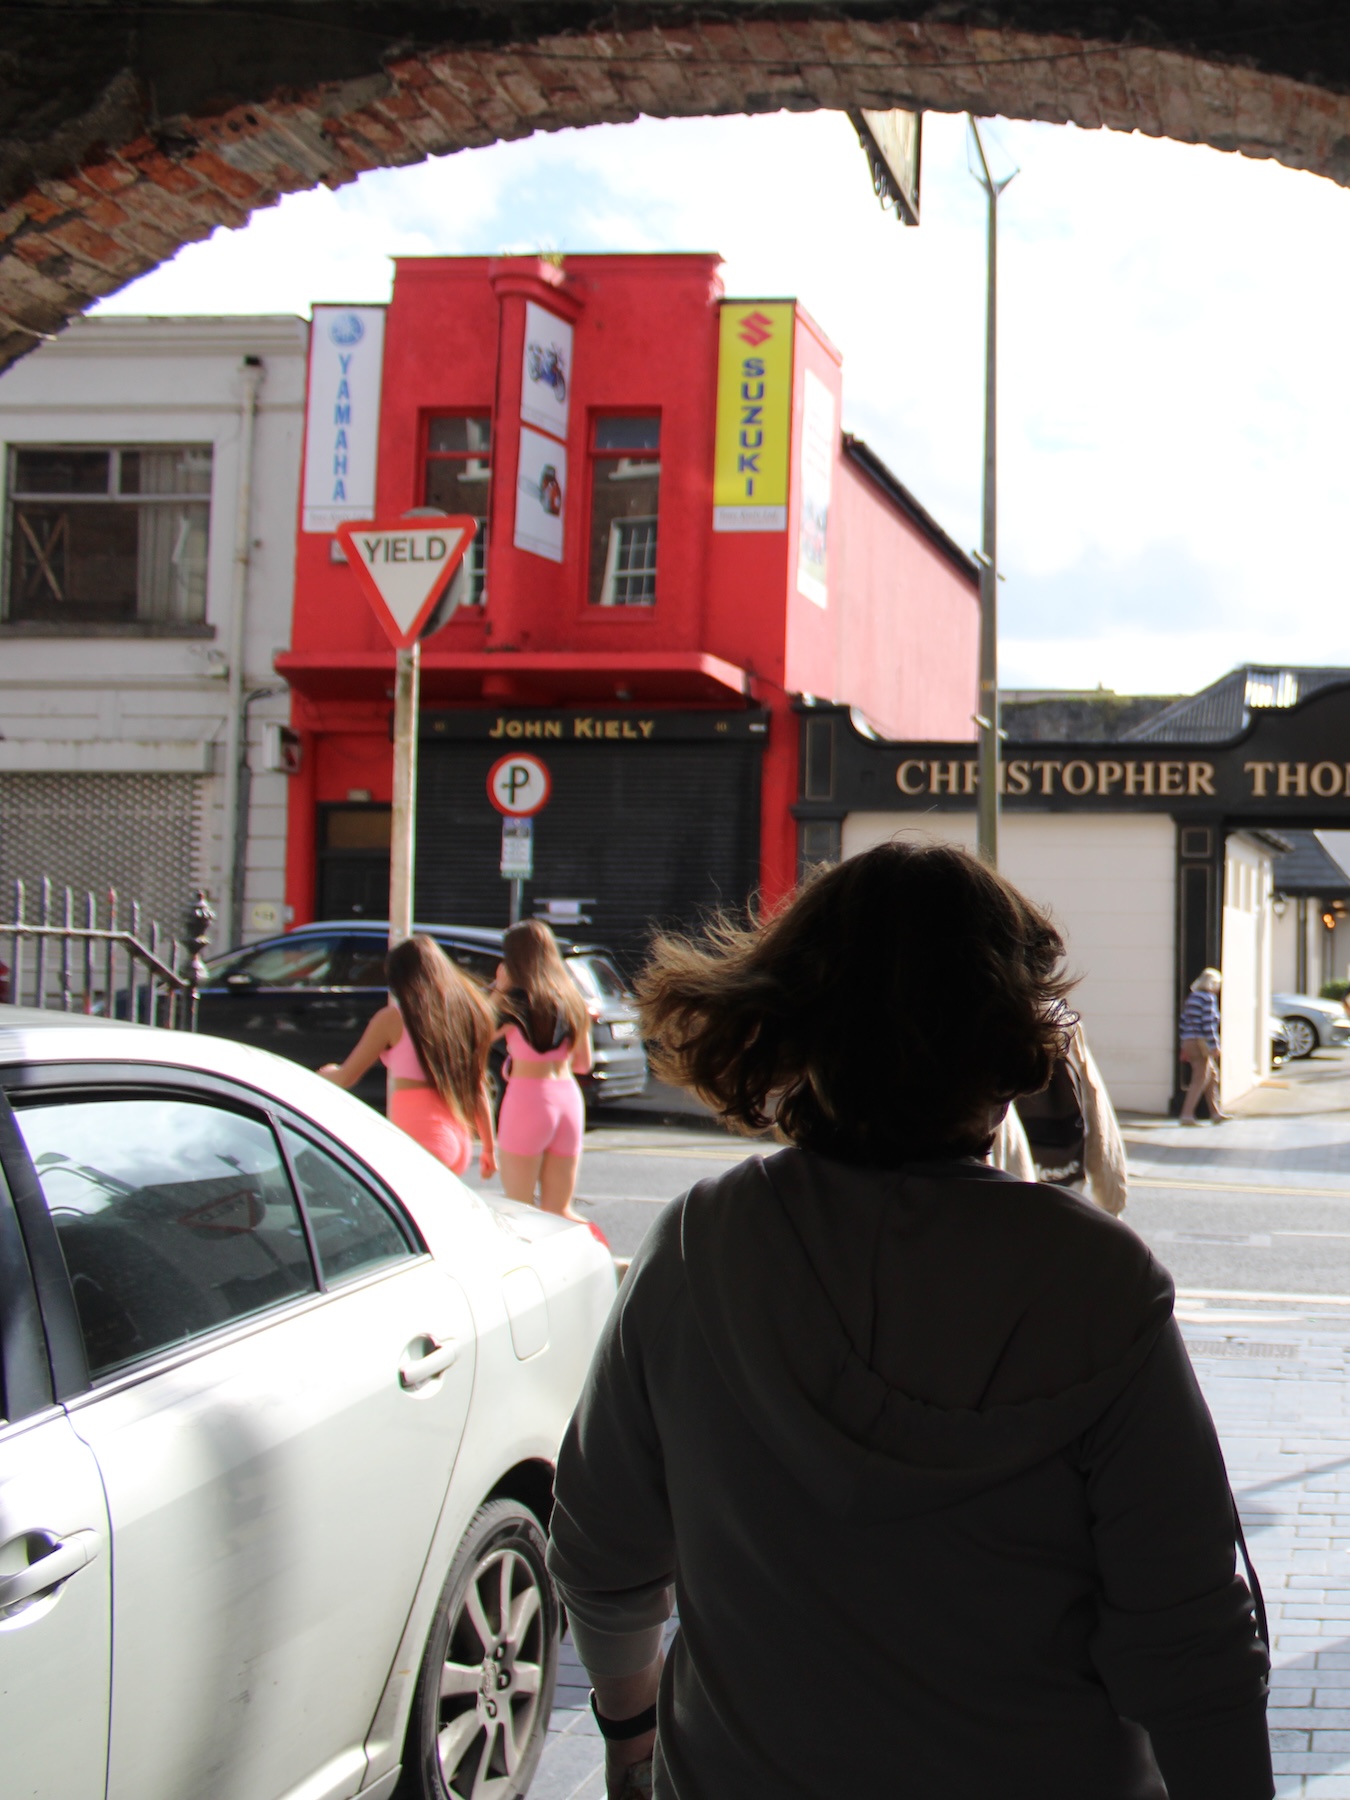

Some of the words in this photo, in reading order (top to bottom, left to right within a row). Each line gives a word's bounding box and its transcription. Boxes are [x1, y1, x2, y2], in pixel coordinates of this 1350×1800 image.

[333, 353, 351, 501] YAMAHA
[736, 357, 765, 498] SUZUKI
[363, 536, 447, 564] YIELD
[488, 717, 563, 738] JOHN
[574, 717, 654, 738] KIELY
[895, 759, 1216, 795] CHRISTOPHER
